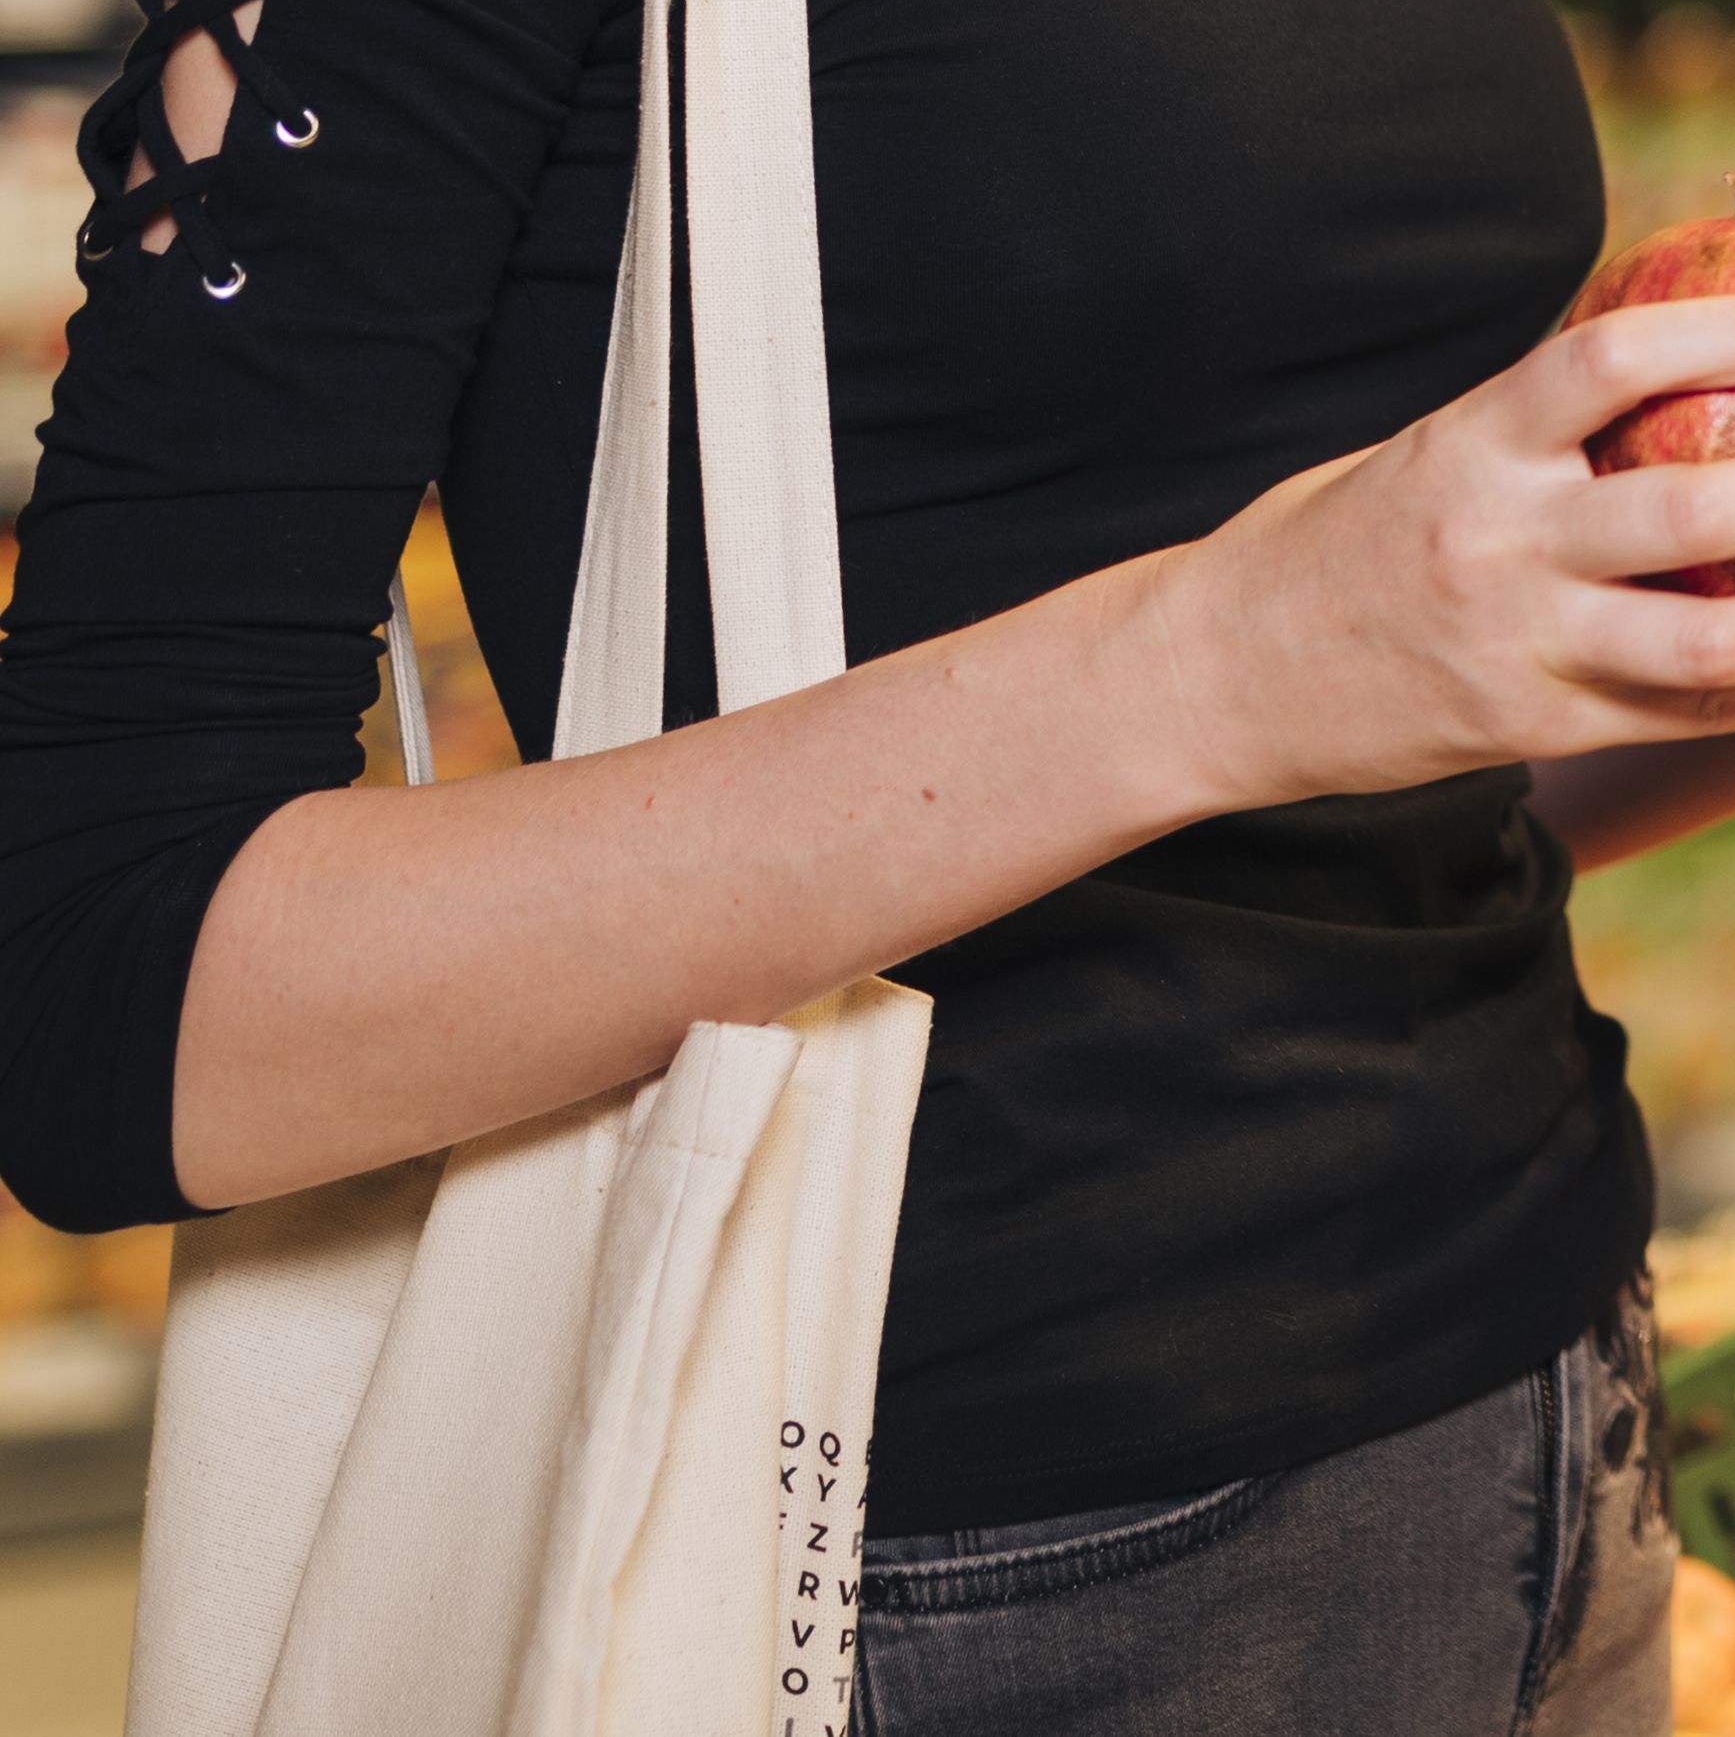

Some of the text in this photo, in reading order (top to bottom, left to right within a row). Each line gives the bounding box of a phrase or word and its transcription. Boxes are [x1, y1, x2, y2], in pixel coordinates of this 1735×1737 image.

[780, 1420, 805, 1449] O
[819, 1431, 841, 1467] Q
[817, 1473, 837, 1502] Y
[807, 1522, 829, 1553] Z
[797, 1570, 820, 1601] R
[791, 1619, 855, 1655] V P
[781, 1667, 850, 1704] O T
